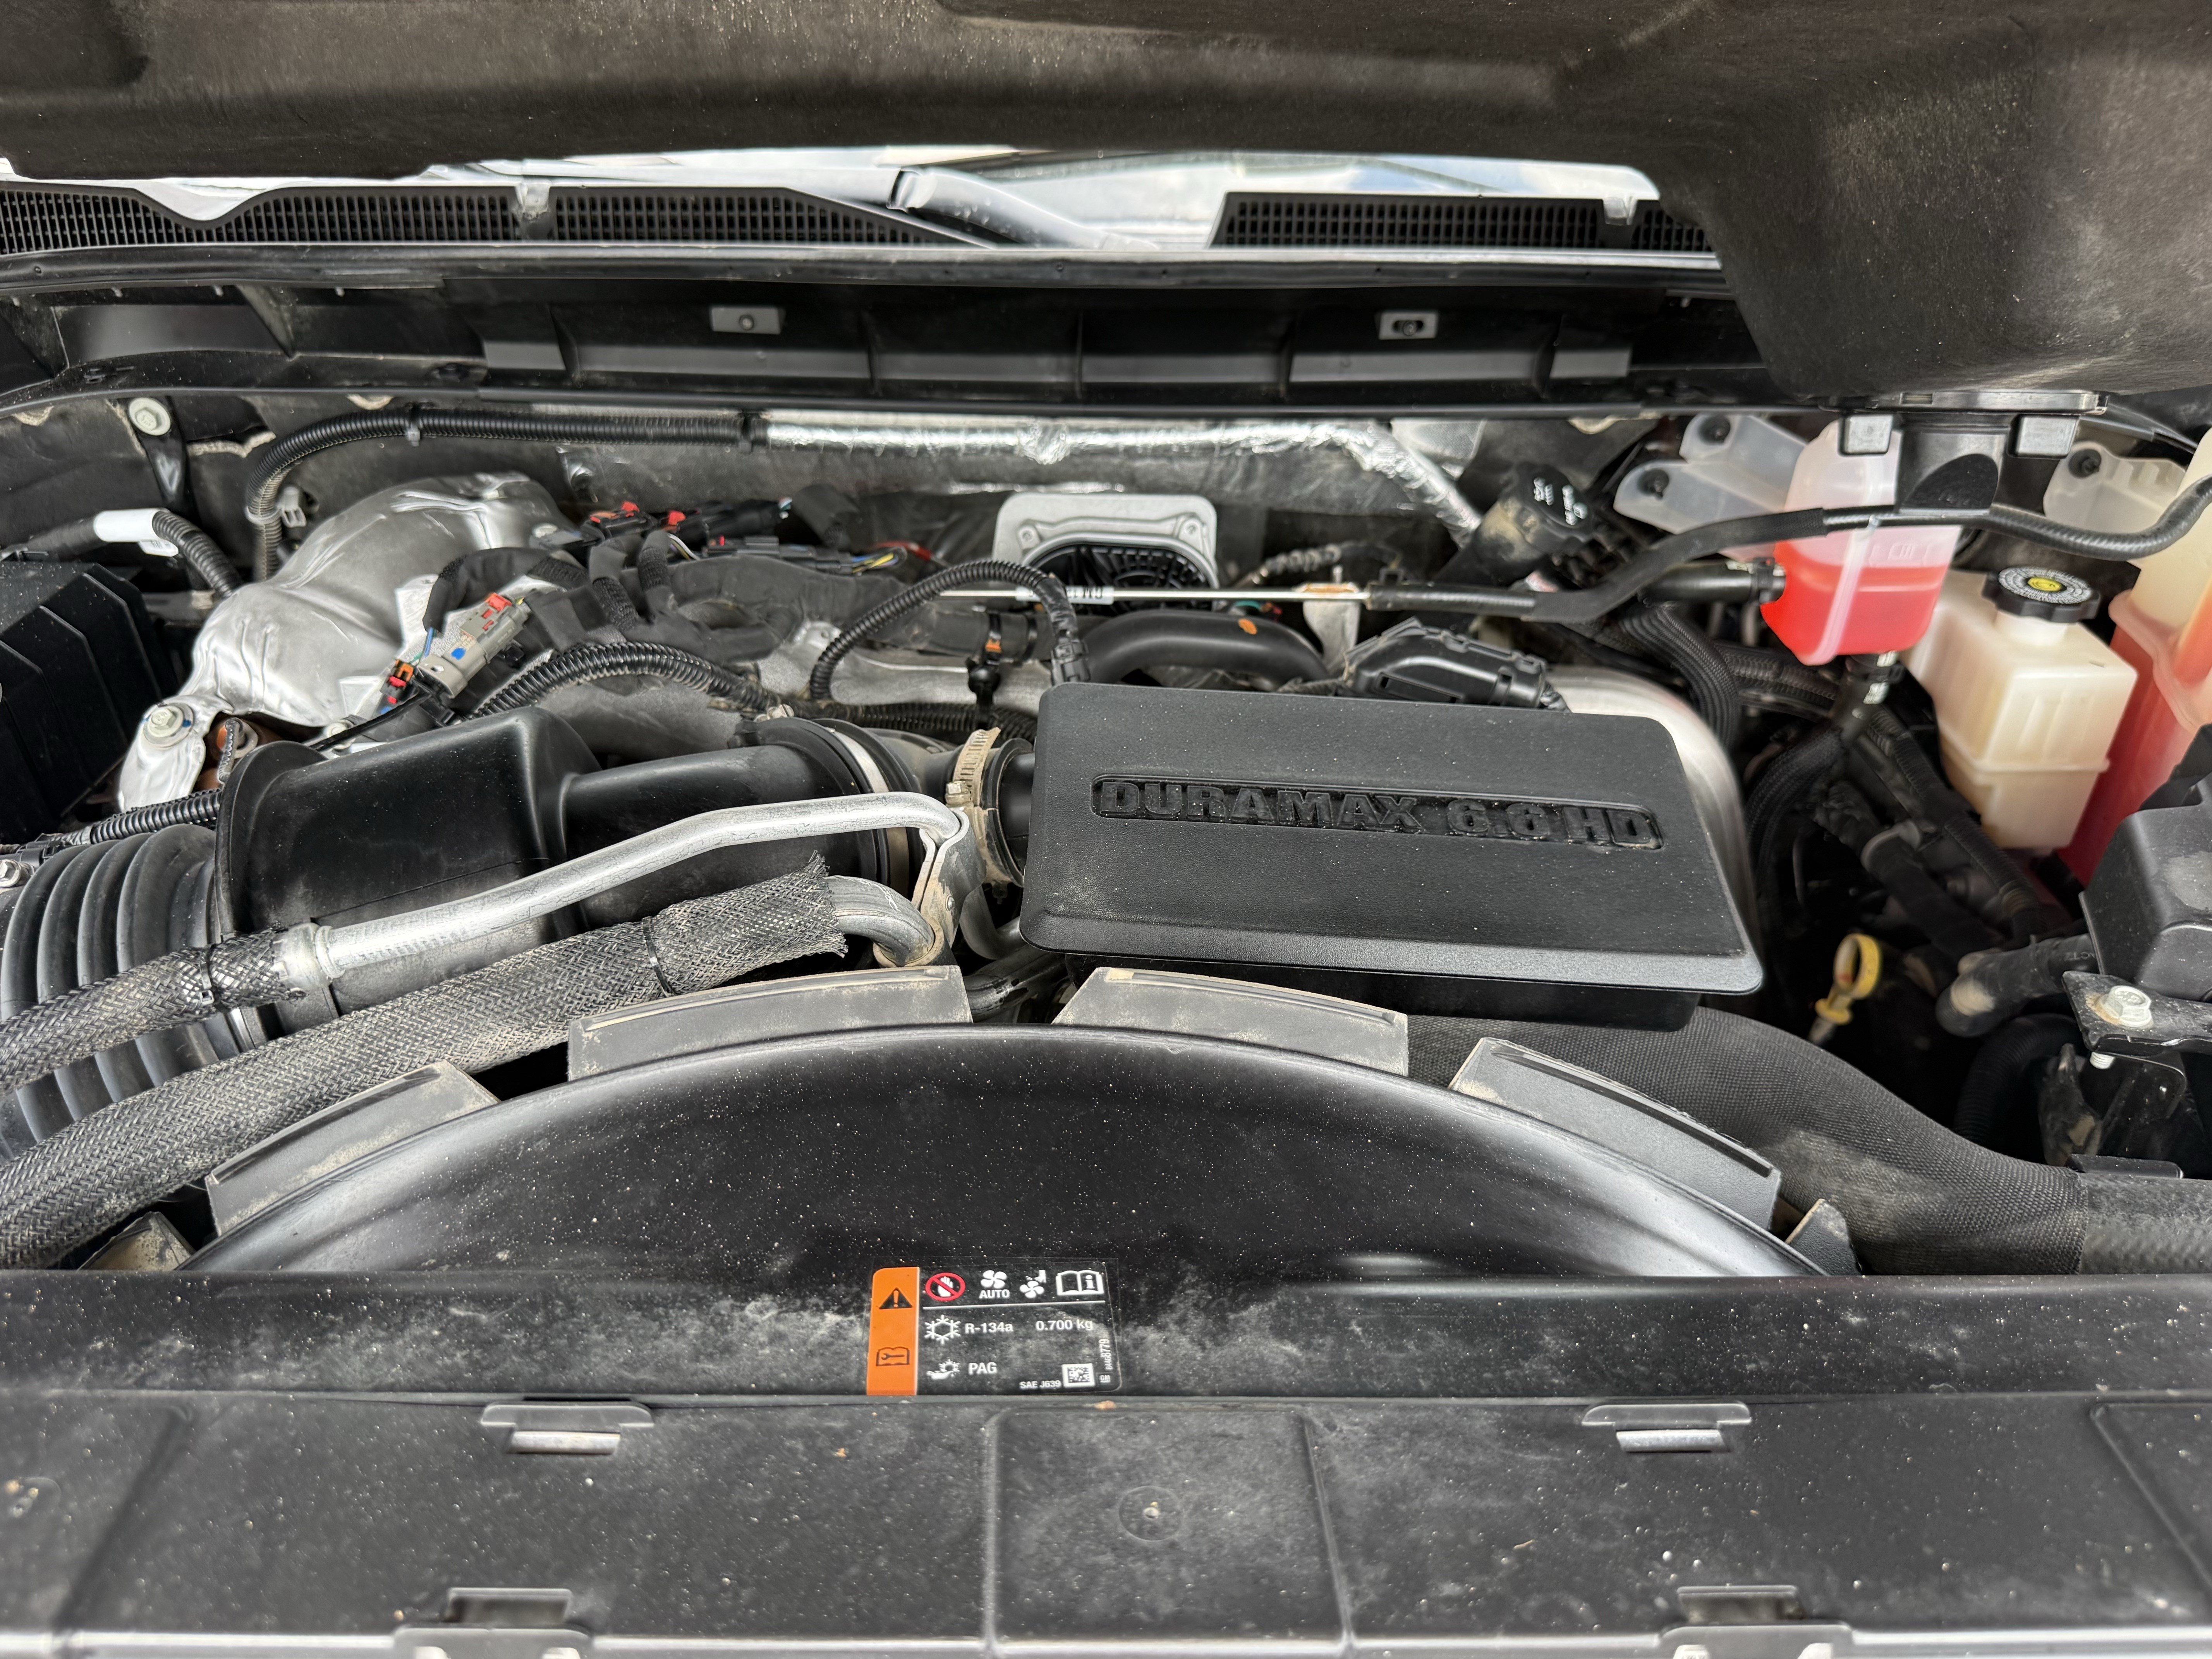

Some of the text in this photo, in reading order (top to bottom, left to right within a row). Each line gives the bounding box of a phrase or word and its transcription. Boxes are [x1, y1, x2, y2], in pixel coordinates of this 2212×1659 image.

[1101, 781, 1422, 828] DURAMAX
[979, 1289, 1010, 1298] AUTO
[965, 1322, 1014, 1334] R-134a
[1035, 1319, 1093, 1331] 0.700 kg
[968, 1362, 997, 1374] PAG
[1099, 1374, 1111, 1382] GM
[1019, 1380, 1061, 1389] SAE J639
